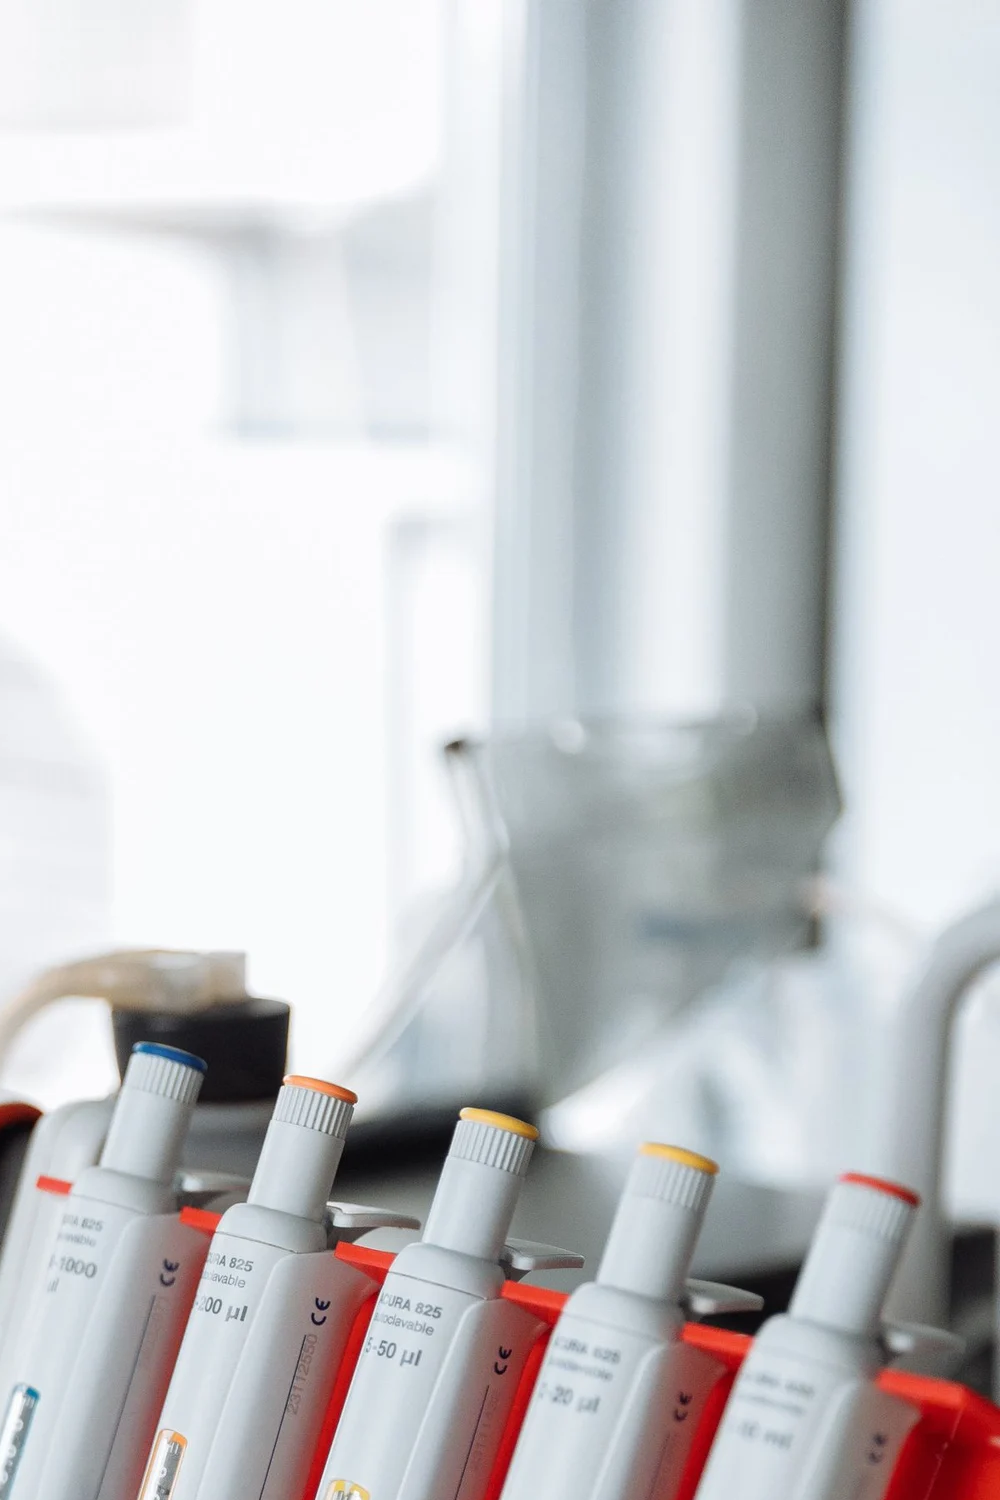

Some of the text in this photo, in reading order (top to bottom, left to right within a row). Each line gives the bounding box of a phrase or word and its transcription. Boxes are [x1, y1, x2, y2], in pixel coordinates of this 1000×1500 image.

[229, 1257, 255, 1273] 825
[414, 1302, 444, 1320] 825
[399, 1349, 424, 1368] µl
